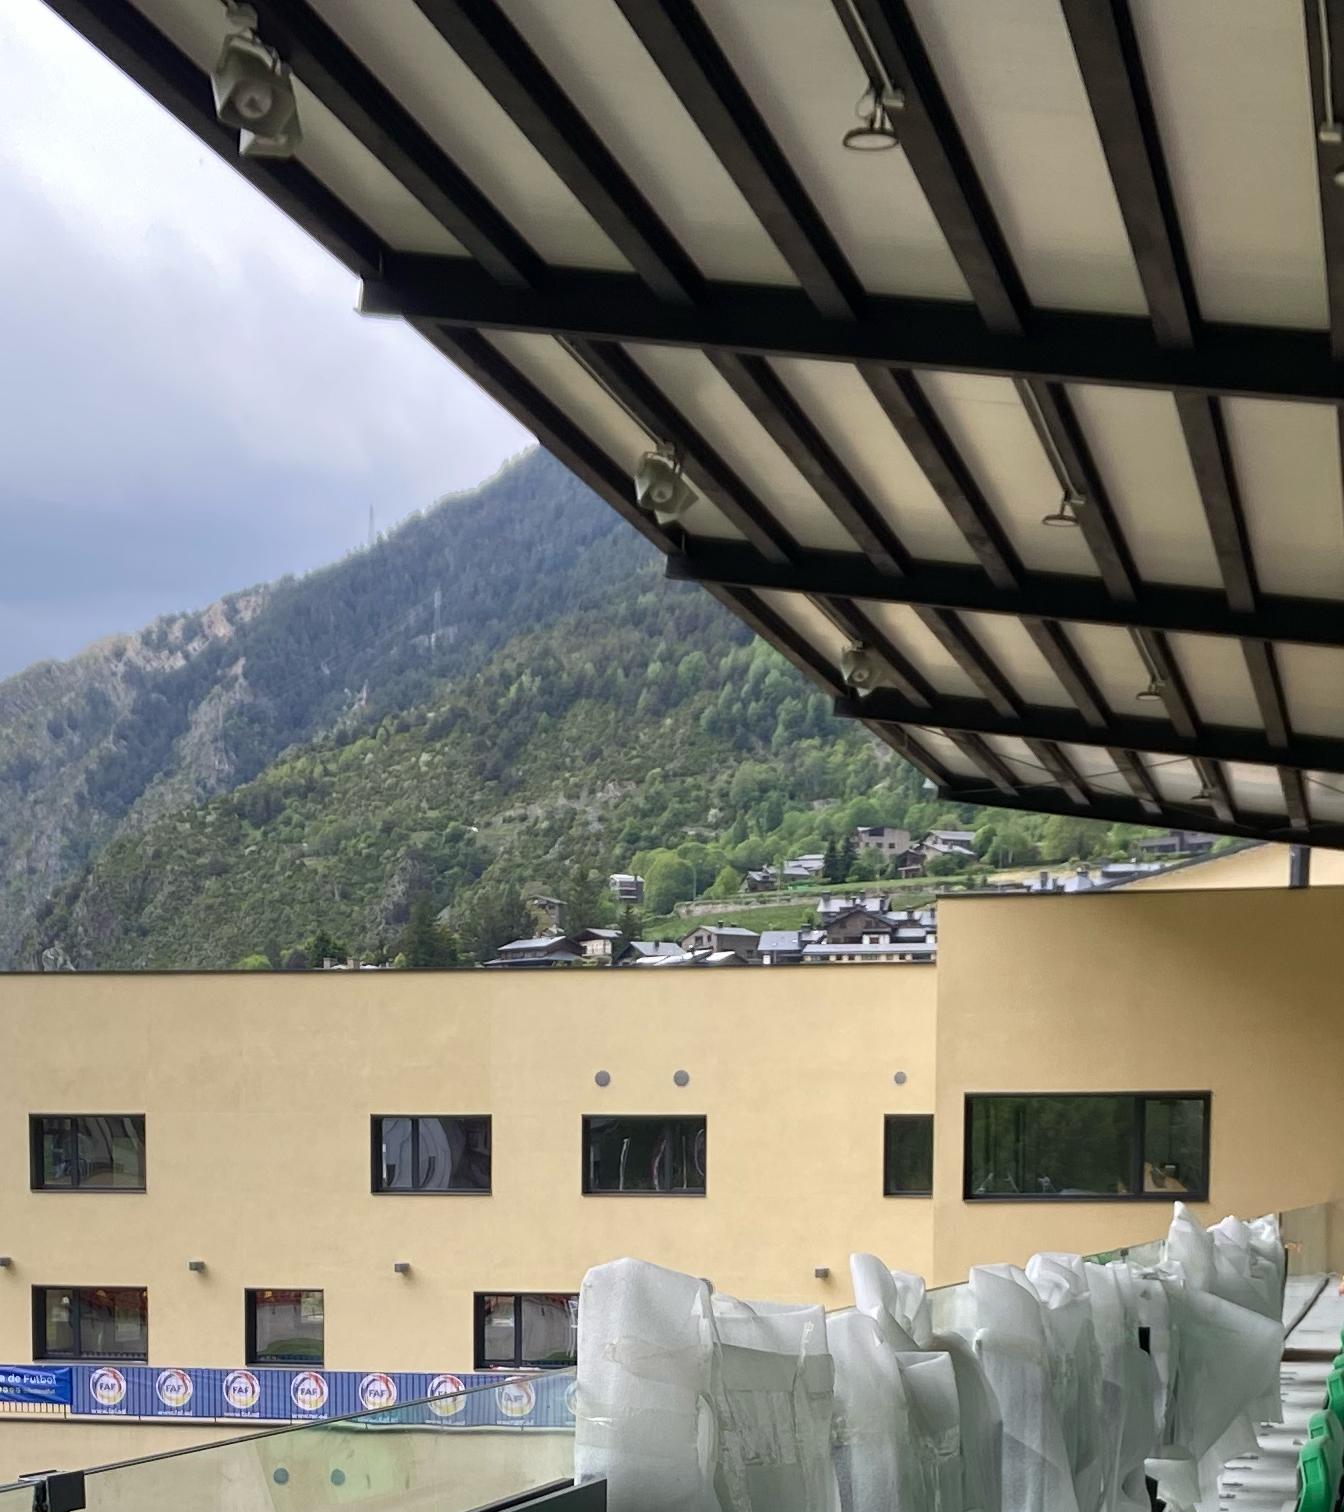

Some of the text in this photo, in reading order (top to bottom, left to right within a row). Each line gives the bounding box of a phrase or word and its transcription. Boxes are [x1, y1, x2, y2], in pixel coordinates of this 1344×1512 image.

[7, 1373, 21, 1383] de
[99, 1383, 116, 1391] FAF
[165, 1384, 183, 1393] FAF
[300, 1388, 317, 1396] FAF
[368, 1389, 387, 1398] FAF
